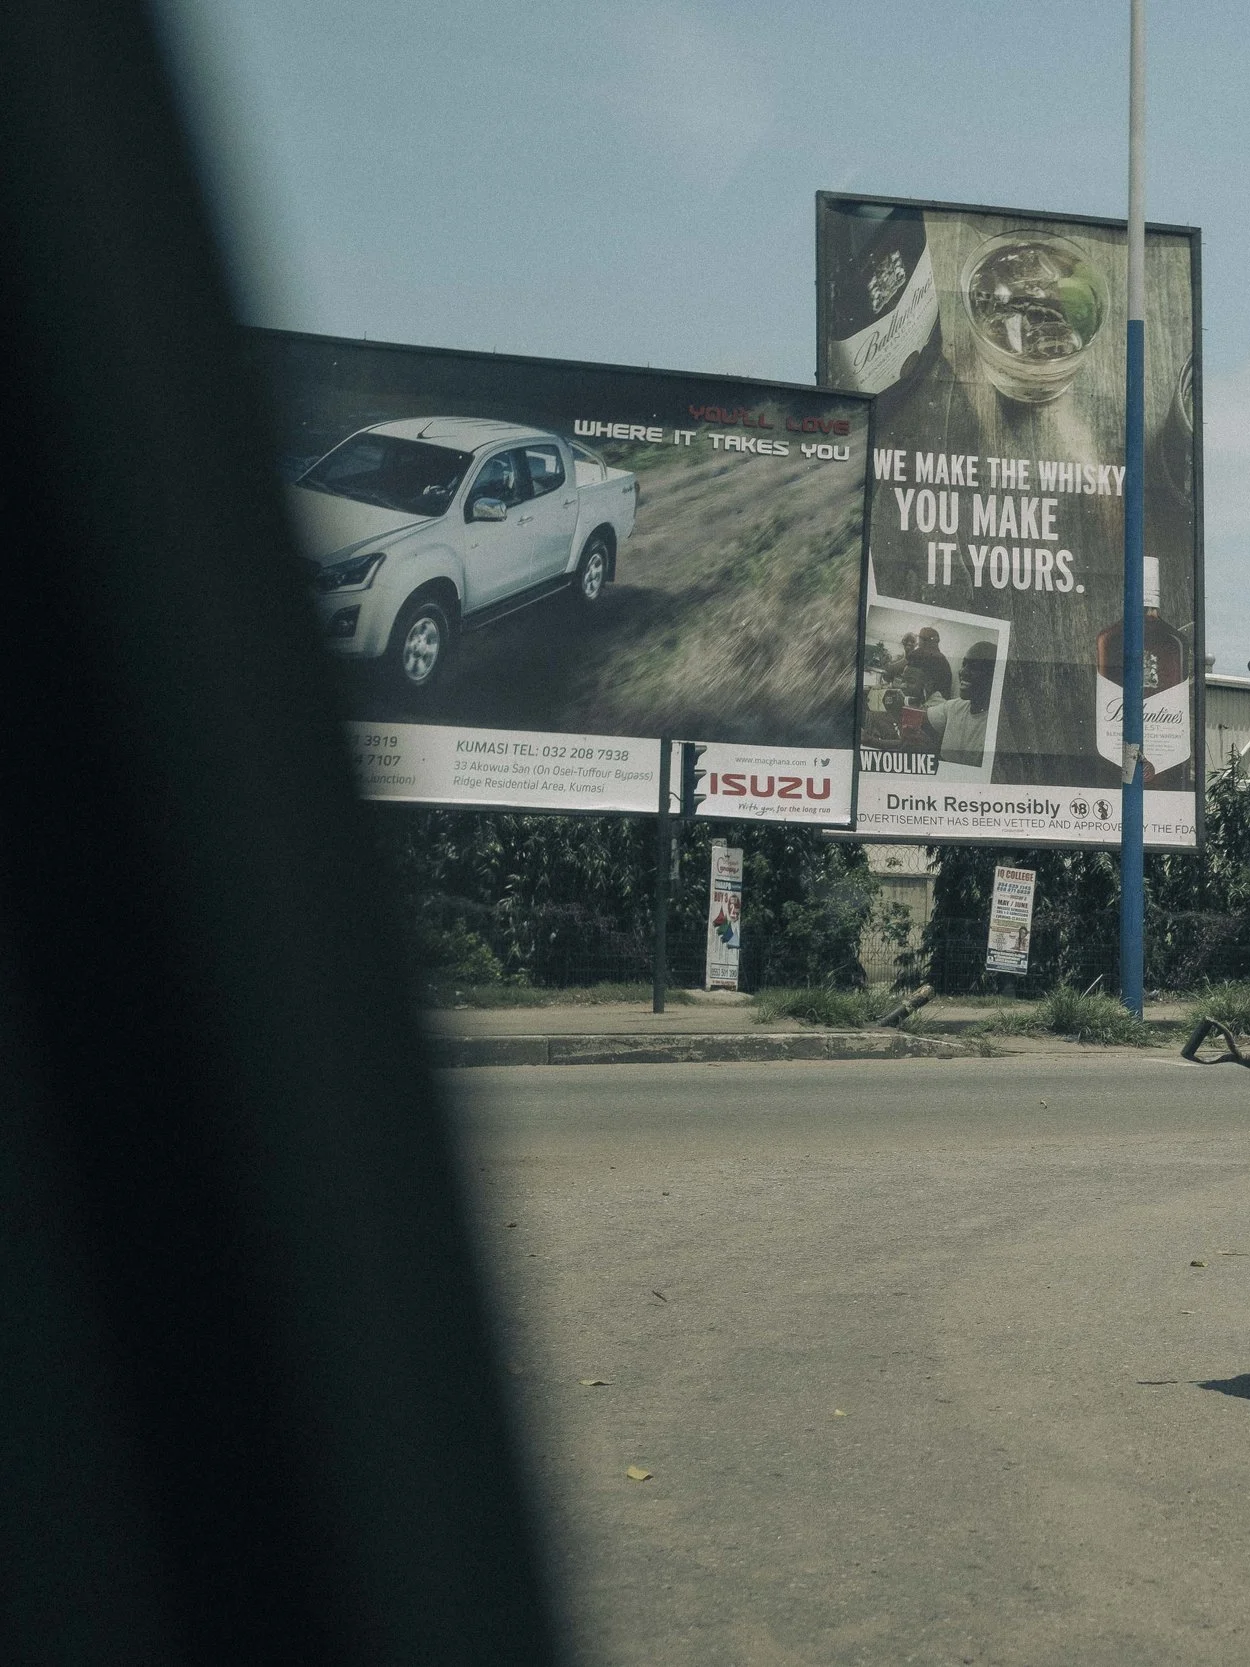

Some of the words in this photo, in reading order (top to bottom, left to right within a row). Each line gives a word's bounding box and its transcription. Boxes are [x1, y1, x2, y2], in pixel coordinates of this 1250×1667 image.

[689, 404, 774, 429] YOU'LL
[785, 416, 850, 436] LOVE
[574, 420, 663, 442] WHERE
[674, 430, 696, 446] IT
[708, 434, 790, 457] TAKES
[801, 443, 850, 461] YOU
[873, 448, 907, 482] WE
[916, 451, 979, 487] MAKE
[987, 457, 1030, 490] THE
[1039, 460, 1126, 496] WHISKY
[894, 488, 959, 534] YOU
[972, 494, 1059, 540] MAKE
[928, 542, 957, 586] IT
[968, 544, 1085, 594] YOURS.
[364, 735, 398, 748] 3919
[456, 740, 508, 756] KUMASI
[512, 742, 539, 757] TEL:
[542, 746, 566, 758] 032
[570, 747, 593, 760] 208
[598, 748, 630, 762] 7938
[367, 754, 402, 767] 7107
[454, 761, 468, 771] 33
[553, 766, 613, 780] Osei-Tuffour
[736, 757, 807, 766] www.macghana.com
[454, 776, 482, 789] Ridge
[484, 777, 540, 792] Residential
[541, 780, 566, 793] Area,
[569, 782, 606, 794] Kumasi
[710, 772, 831, 800] ISUZU
[776, 806, 787, 816] for
[802, 806, 817, 814] long
[886, 794, 938, 812] Drink
[944, 796, 1060, 819] Responsibly
[948, 817, 969, 827] HAS
[972, 817, 1000, 828] BEEN
[1004, 818, 1045, 828] VETTED
[1048, 820, 1071, 830] AND
[1074, 822, 1122, 832] APPROVE
[1152, 824, 1172, 833] THE
[1175, 825, 1197, 834] FDA
[1006, 870, 1034, 882] COLLEGE
